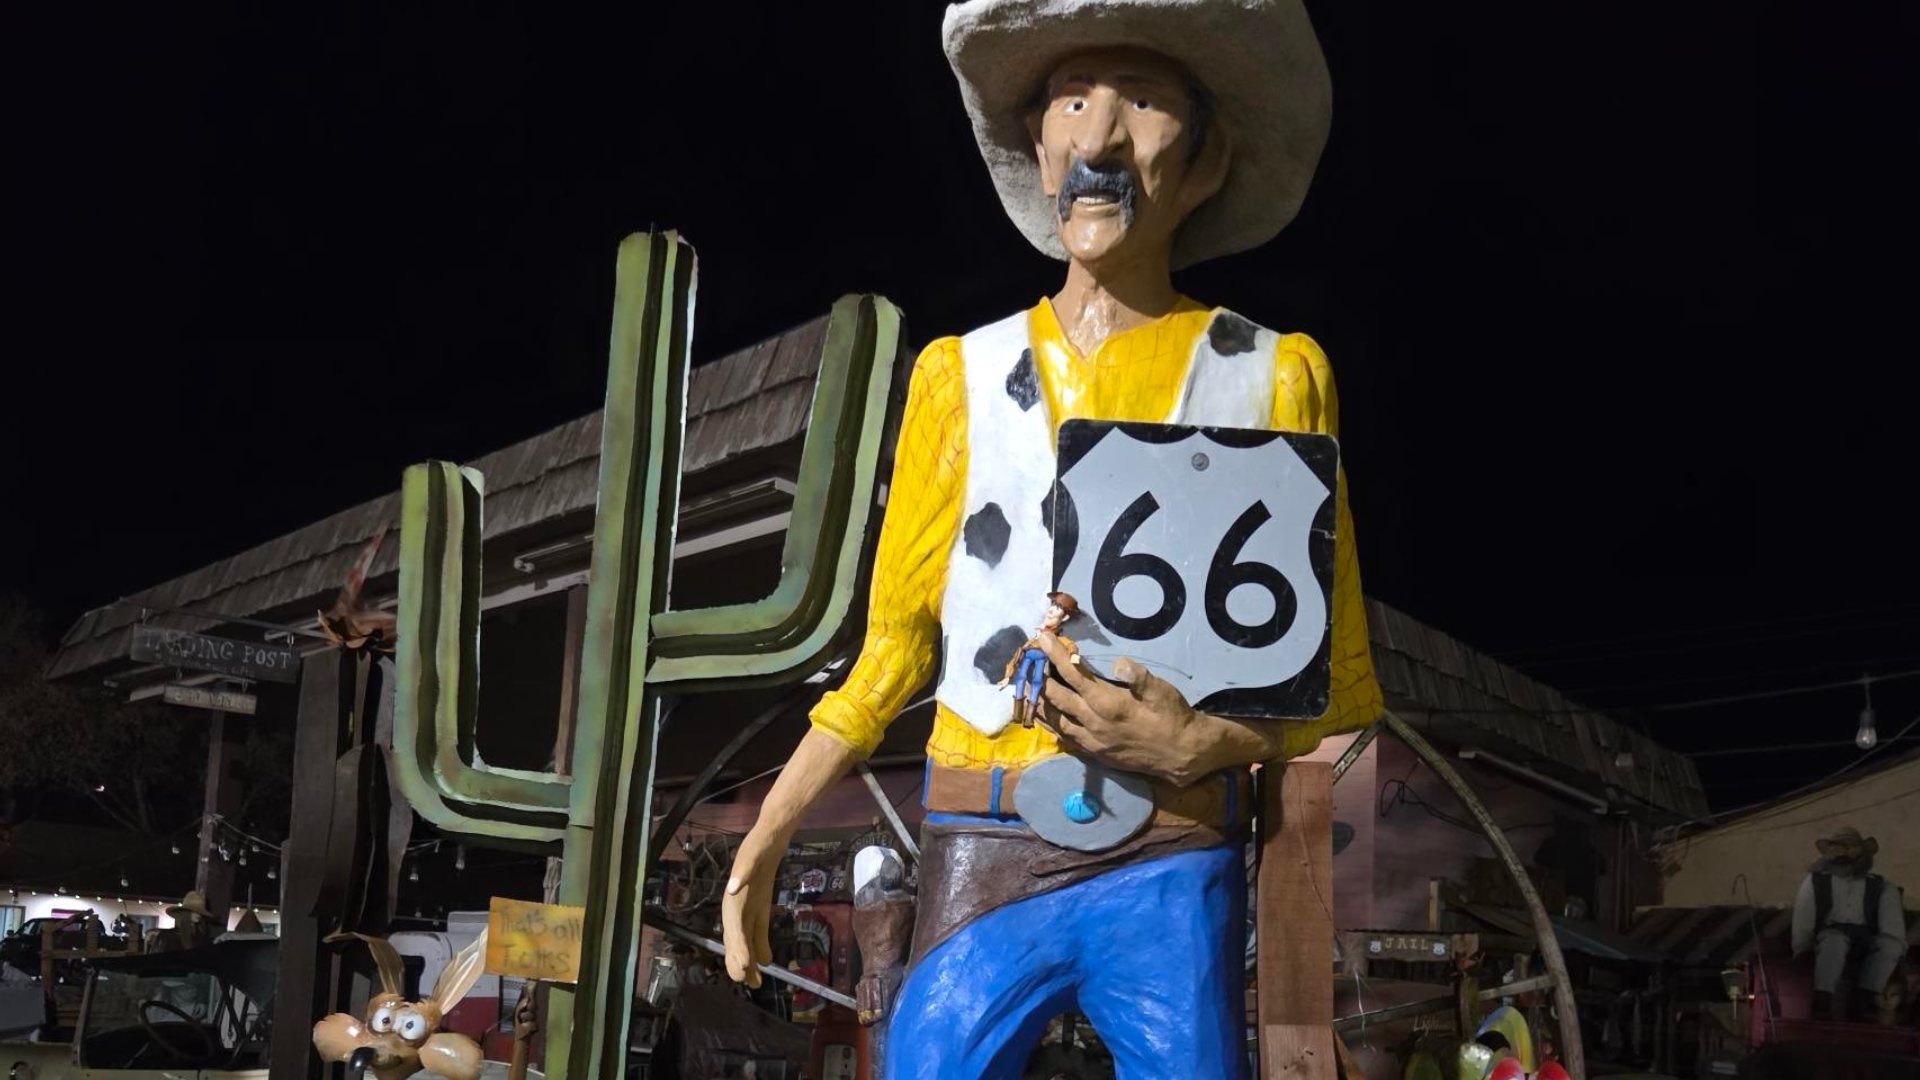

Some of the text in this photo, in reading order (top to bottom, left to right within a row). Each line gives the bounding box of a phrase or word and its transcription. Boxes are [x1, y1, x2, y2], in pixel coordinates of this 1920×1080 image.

[1091, 491, 1298, 650] 66
[143, 628, 234, 660] TRADING
[242, 645, 292, 669] POST
[553, 917, 581, 942] all
[1385, 937, 1428, 950] JAIL
